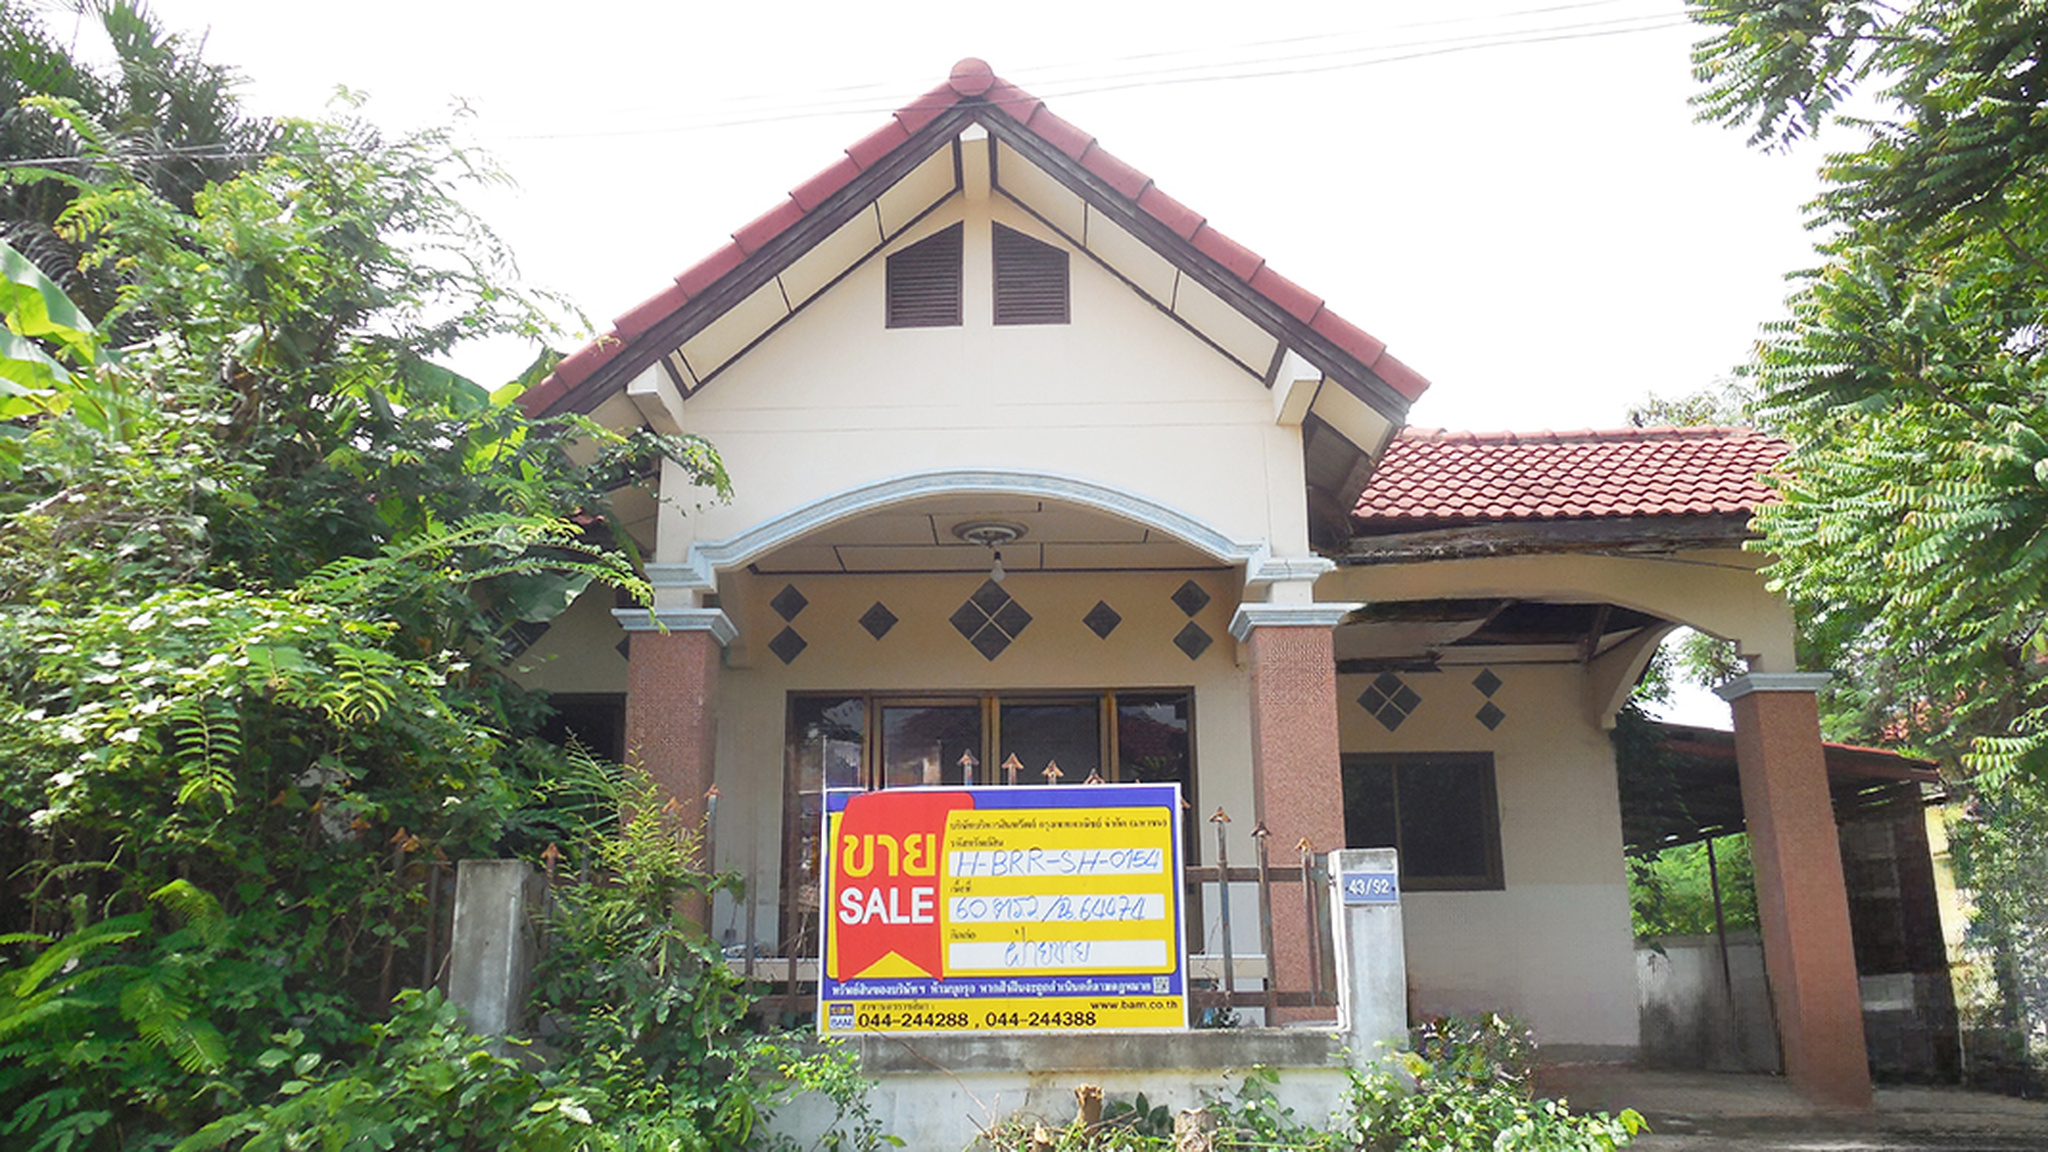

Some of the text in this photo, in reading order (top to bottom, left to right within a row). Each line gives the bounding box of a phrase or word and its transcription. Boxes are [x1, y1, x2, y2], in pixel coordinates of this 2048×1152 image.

[843, 833, 936, 877] ขาย
[956, 847, 1161, 877] H-BRR-SH-0154
[1349, 878, 1390, 896] 43/92
[839, 887, 934, 924] SALE
[1090, 999, 1178, 1010] www.bam.co.th
[858, 1013, 969, 1028] 044-244288
[985, 1011, 1097, 1027] 044-244388
